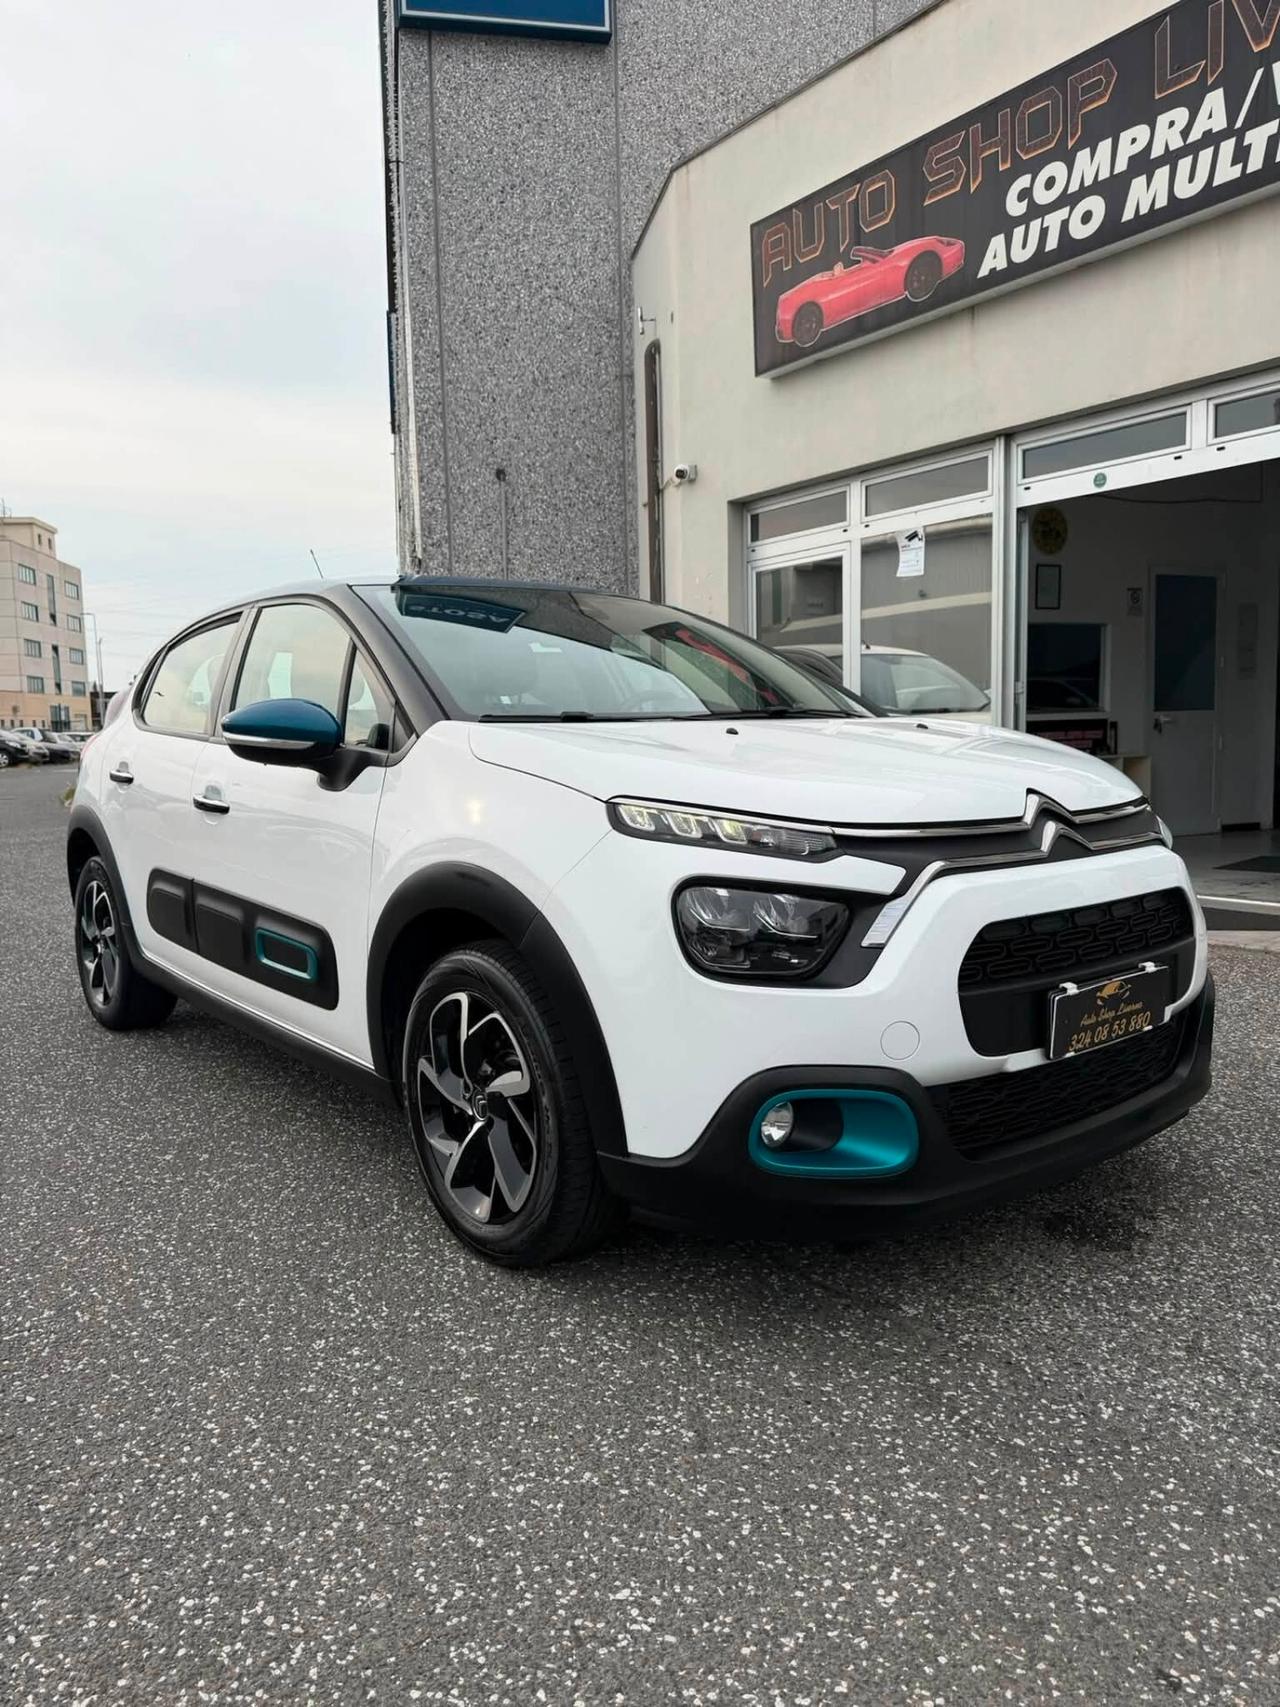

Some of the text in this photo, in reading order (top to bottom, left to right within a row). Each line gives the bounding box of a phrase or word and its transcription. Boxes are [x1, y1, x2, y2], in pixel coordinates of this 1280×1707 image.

[762, 169, 896, 288] AUTO
[922, 57, 1118, 207] SHOP
[976, 118, 1280, 279] AUTO MULT
[1005, 60, 1280, 217] COMPRA/
[1069, 1012, 1151, 1051] 324 08 53 880
